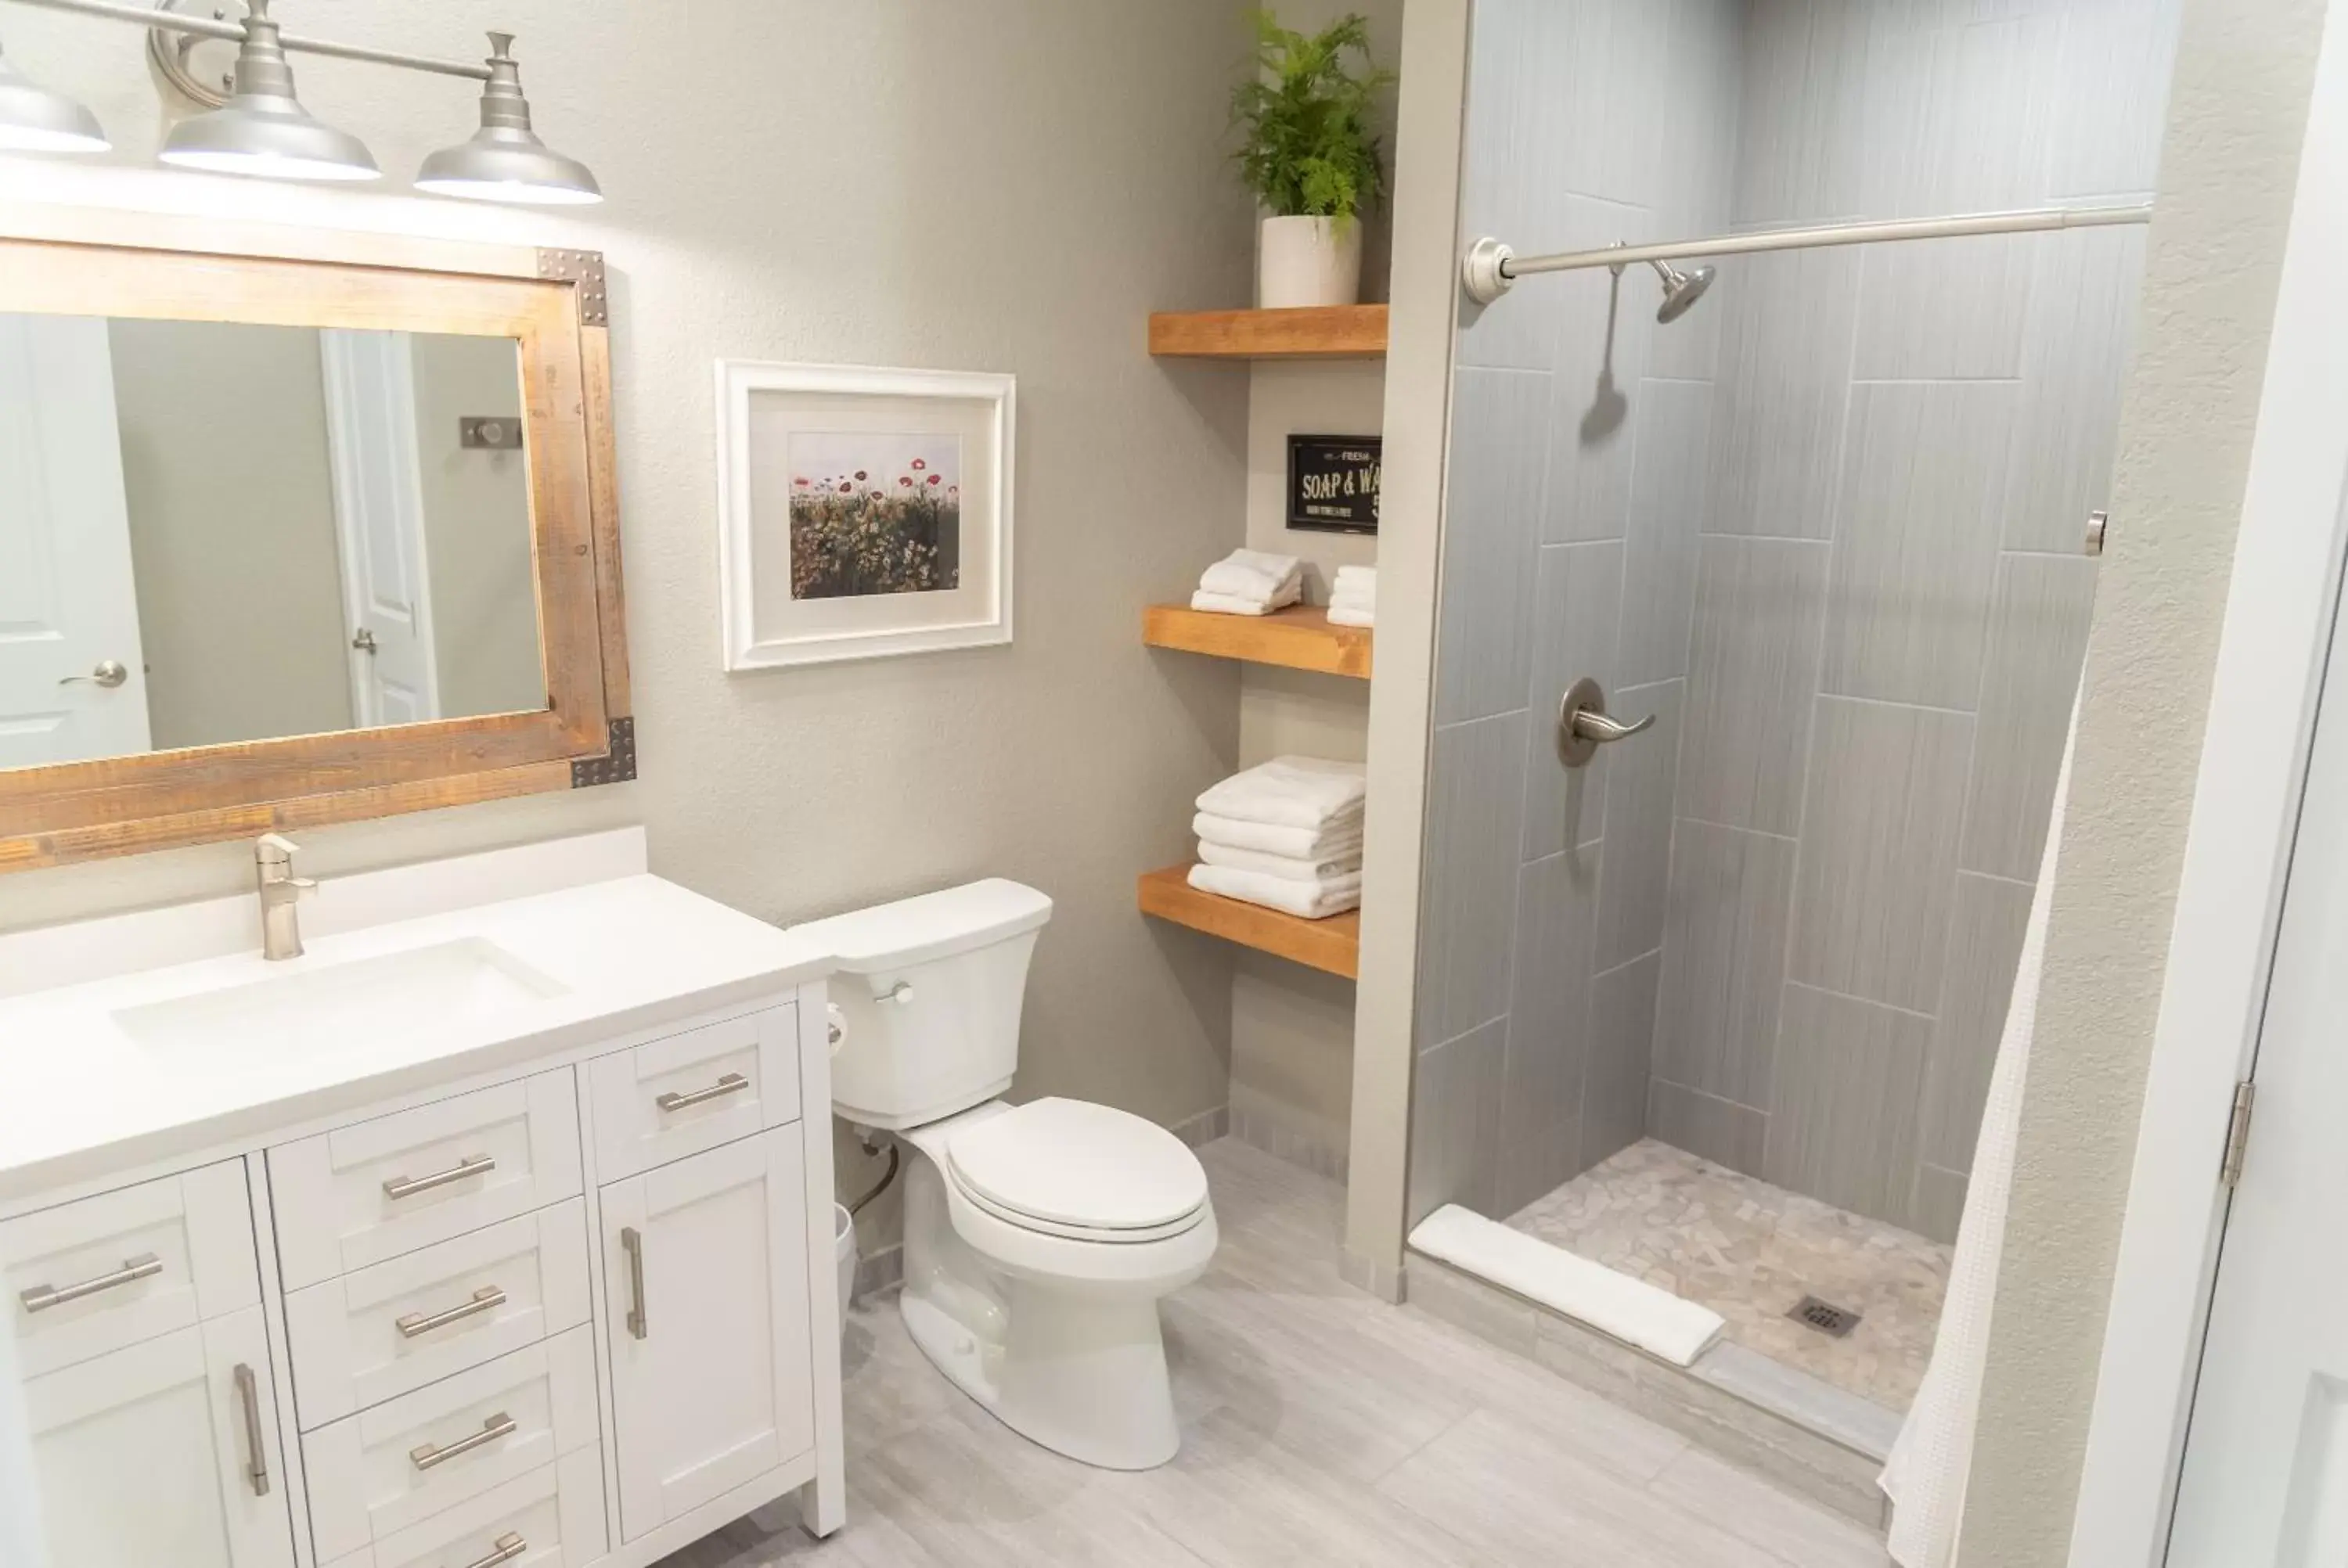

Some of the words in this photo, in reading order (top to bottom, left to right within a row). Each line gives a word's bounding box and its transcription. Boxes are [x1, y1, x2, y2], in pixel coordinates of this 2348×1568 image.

[1341, 451, 1370, 461] FRESH
[1302, 472, 1341, 500] SOAP
[1343, 469, 1355, 496] &
